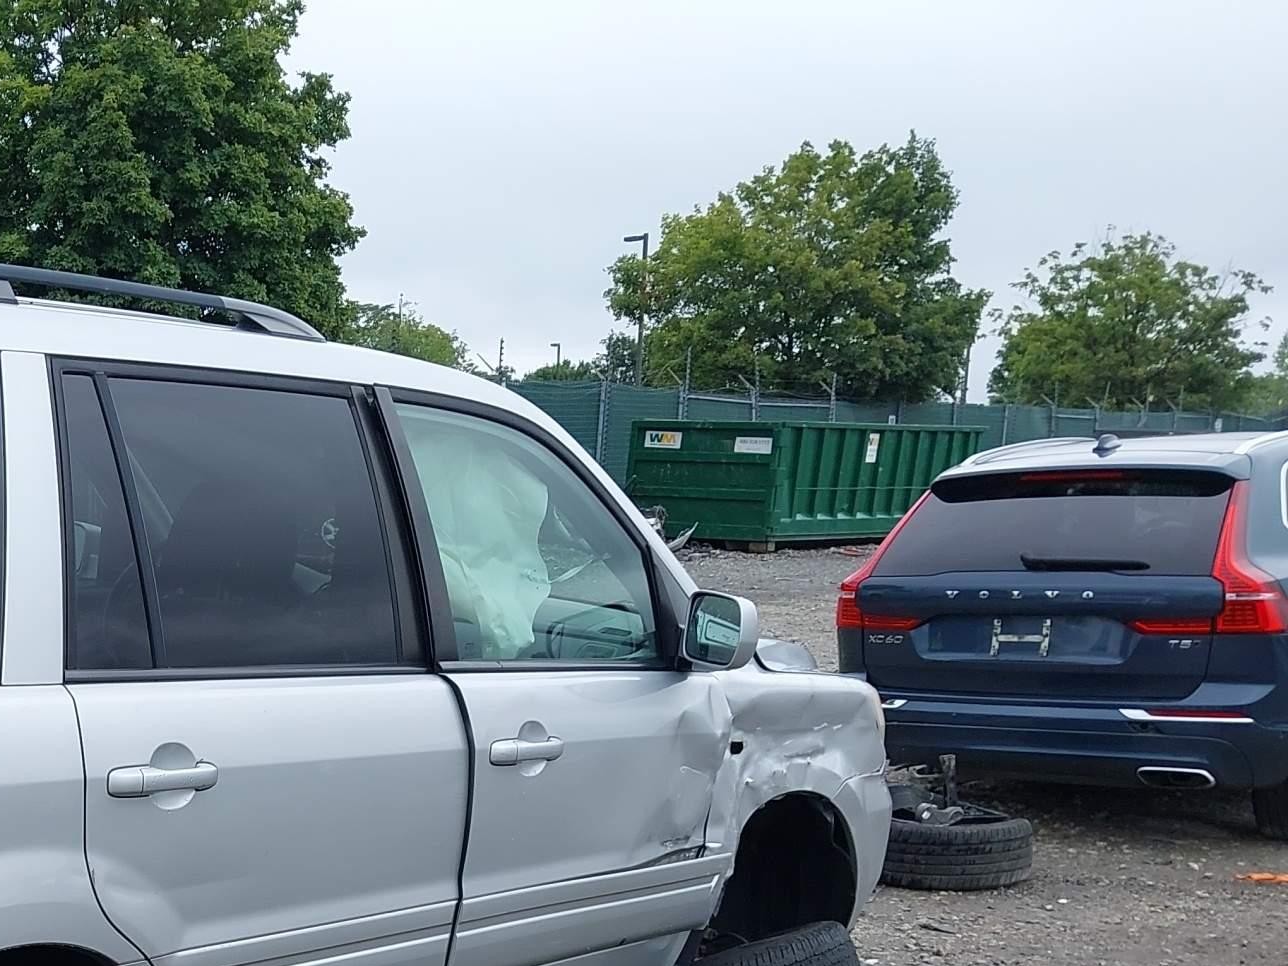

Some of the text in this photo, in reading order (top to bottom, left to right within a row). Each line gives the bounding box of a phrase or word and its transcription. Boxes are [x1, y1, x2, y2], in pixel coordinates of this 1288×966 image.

[649, 432, 676, 443] WM
[945, 590, 1094, 599] VOLVO
[868, 634, 904, 644] XC60
